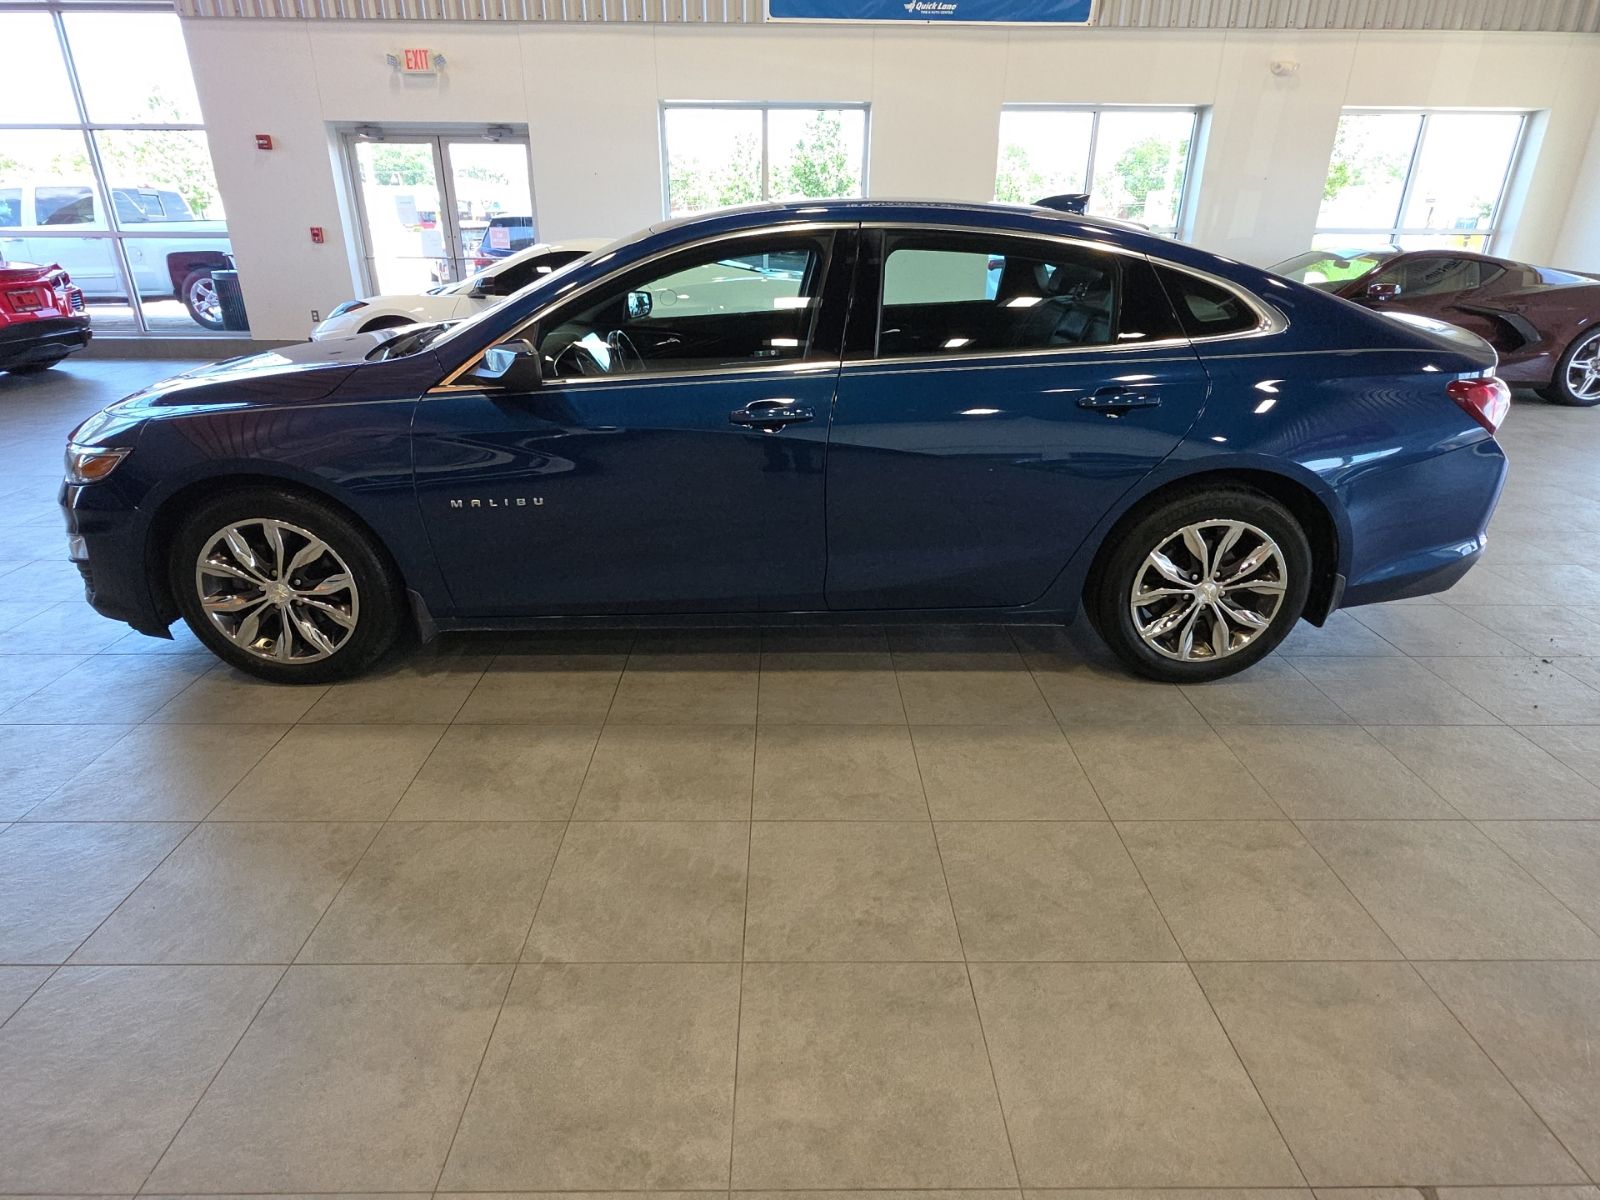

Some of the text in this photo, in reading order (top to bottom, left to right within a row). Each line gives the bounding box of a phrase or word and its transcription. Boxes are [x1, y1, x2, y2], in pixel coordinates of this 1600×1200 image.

[915, 2, 957, 10] Quick Lane
[404, 49, 429, 70] EXIT
[450, 498, 544, 508] MALIBU
